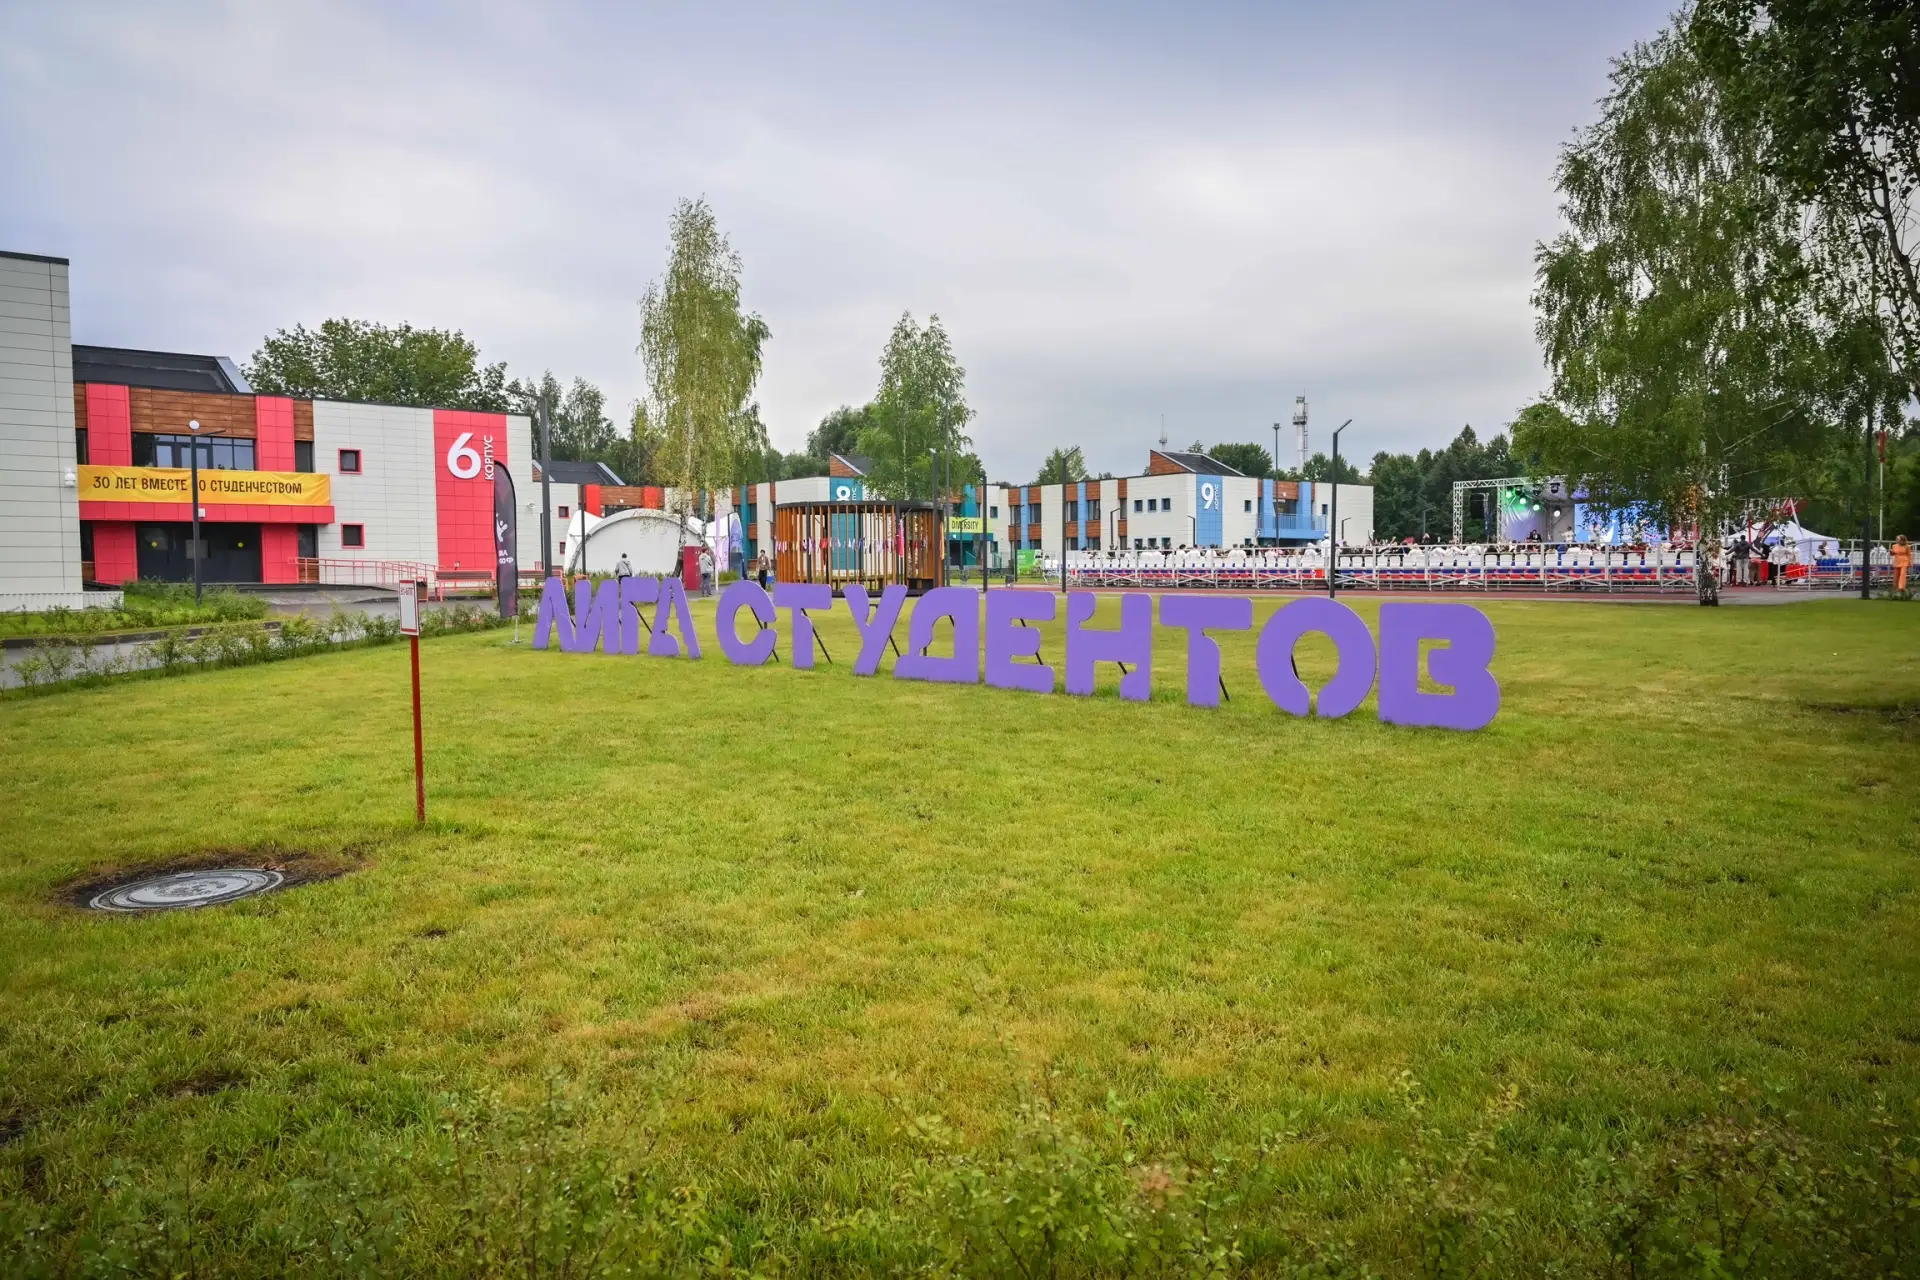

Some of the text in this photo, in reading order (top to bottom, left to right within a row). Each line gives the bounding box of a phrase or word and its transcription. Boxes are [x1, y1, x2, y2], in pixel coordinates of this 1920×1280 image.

[447, 432, 495, 480] 6 КОРПУС
[93, 476, 110, 489] 30
[115, 477, 135, 489] ЛЕТ
[142, 478, 187, 491] ВМЕСТЕ
[211, 480, 302, 494] СТУДЕНЧЕСТВОМ
[1201, 482, 1214, 510] 9
[951, 520, 979, 530] DIVERSITY
[532, 577, 1500, 731] ЛИГА СТУДЕНТОВ
